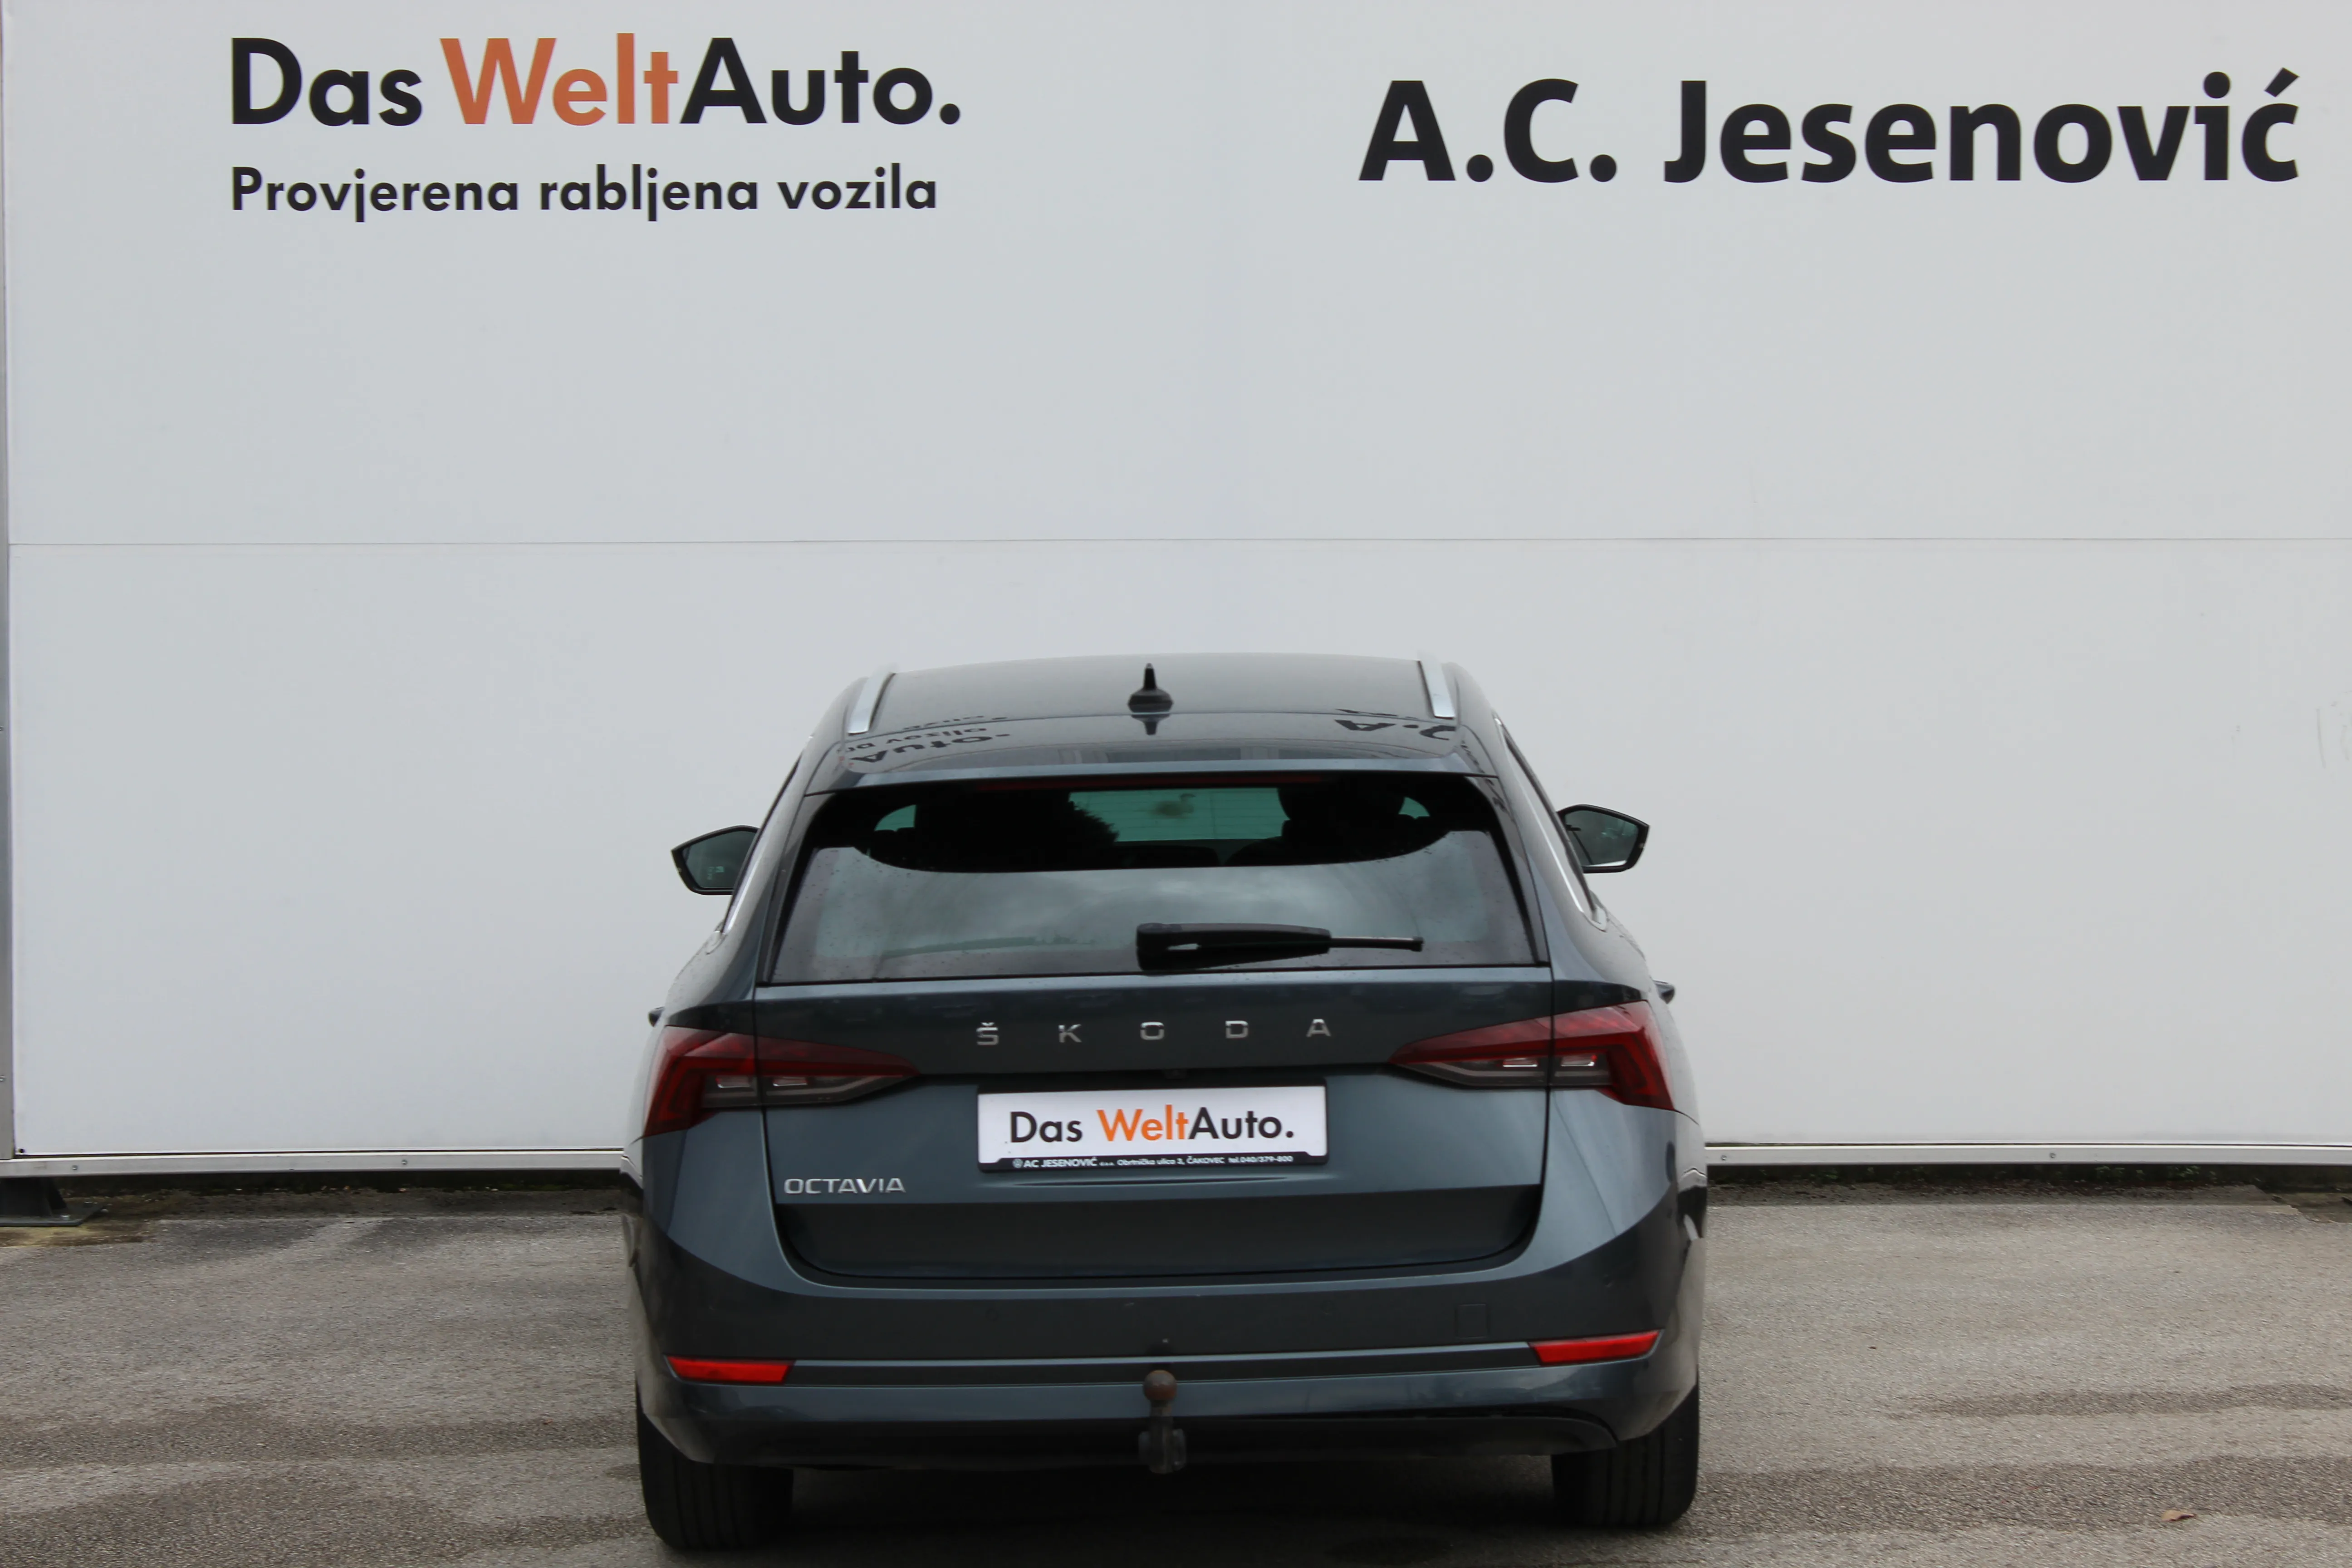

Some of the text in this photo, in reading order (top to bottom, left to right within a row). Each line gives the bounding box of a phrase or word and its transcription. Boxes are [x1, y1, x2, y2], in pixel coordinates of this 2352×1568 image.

[232, 34, 960, 127] Das WeltAuto.
[1359, 68, 2299, 183] A.C. Jesenović
[233, 163, 936, 223] Provjerena rabljena vozila
[976, 1019, 1331, 1045] ŠKODA
[1010, 1104, 1294, 1143] Das WeltAuto.
[1023, 1160, 1039, 1168] AC
[1041, 1157, 1098, 1167] JESENOVIĆ
[1186, 1156, 1225, 1164] ČAKOVEC
[784, 1178, 906, 1194] OCTAVIA
